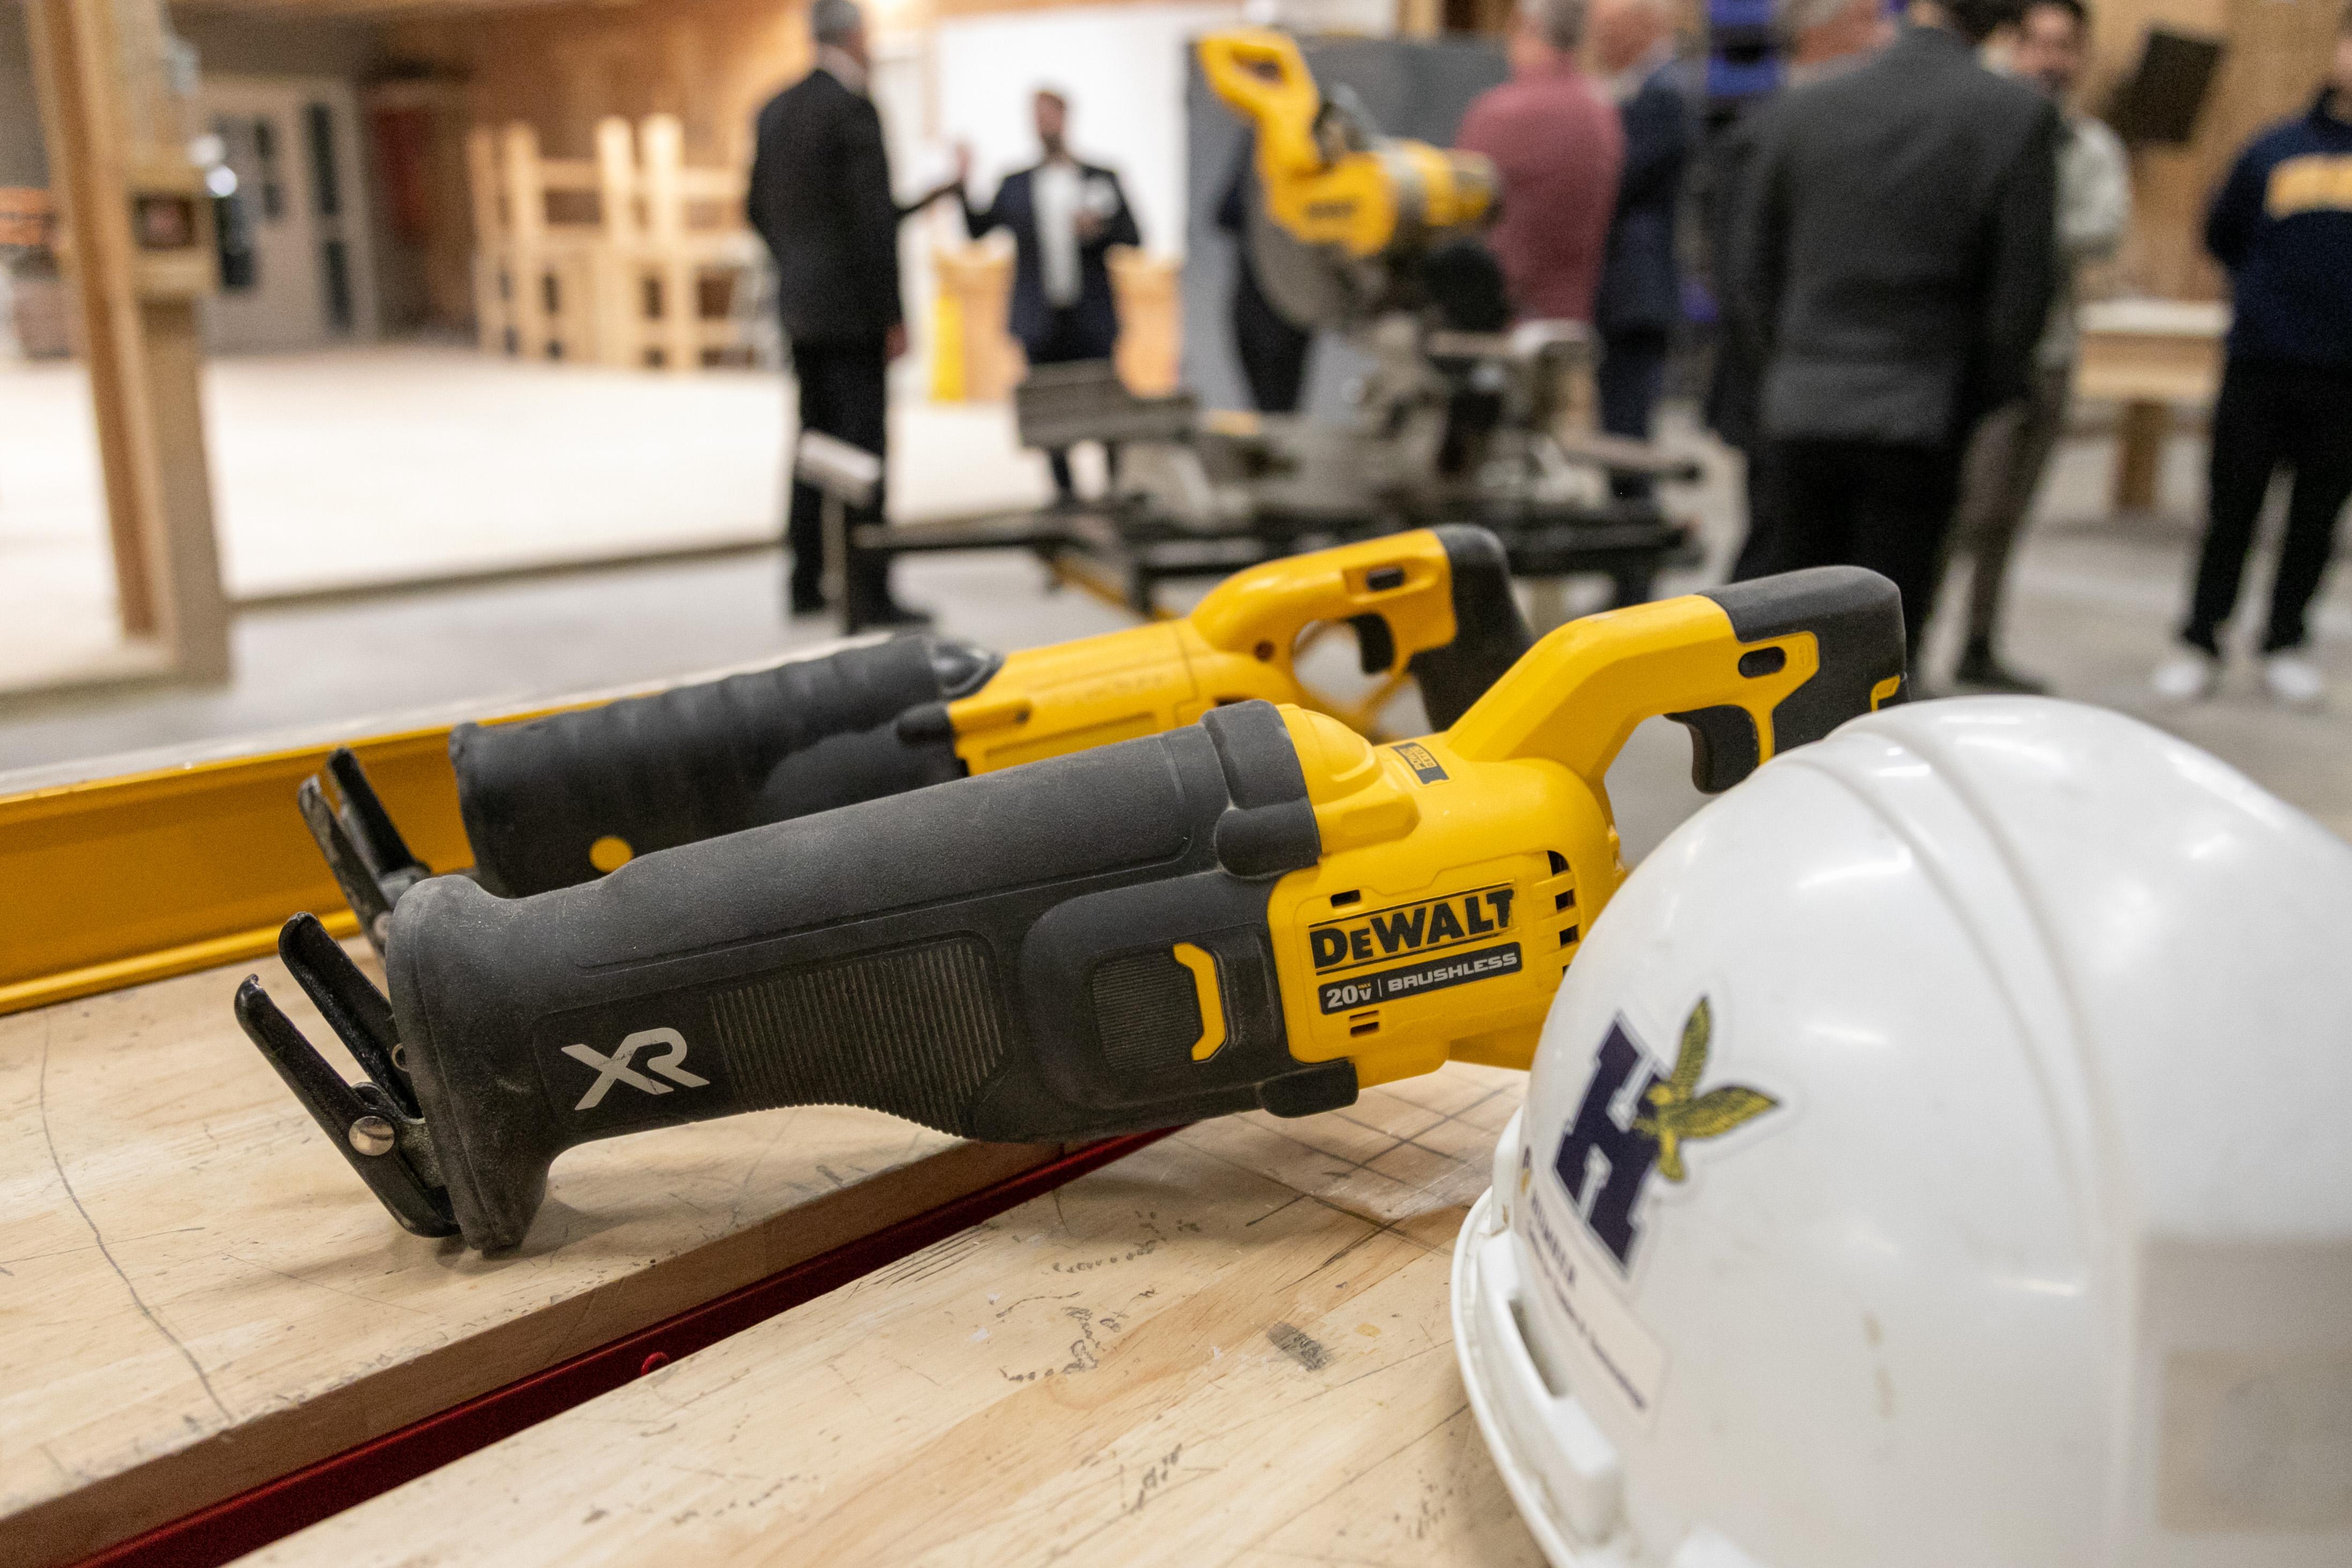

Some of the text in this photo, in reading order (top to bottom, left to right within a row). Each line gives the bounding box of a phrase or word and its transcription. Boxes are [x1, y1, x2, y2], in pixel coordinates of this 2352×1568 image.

[1309, 889, 1514, 969] DEWALT
[1388, 953, 1518, 992] BRUSHLESS
[561, 1028, 710, 1110] XR
